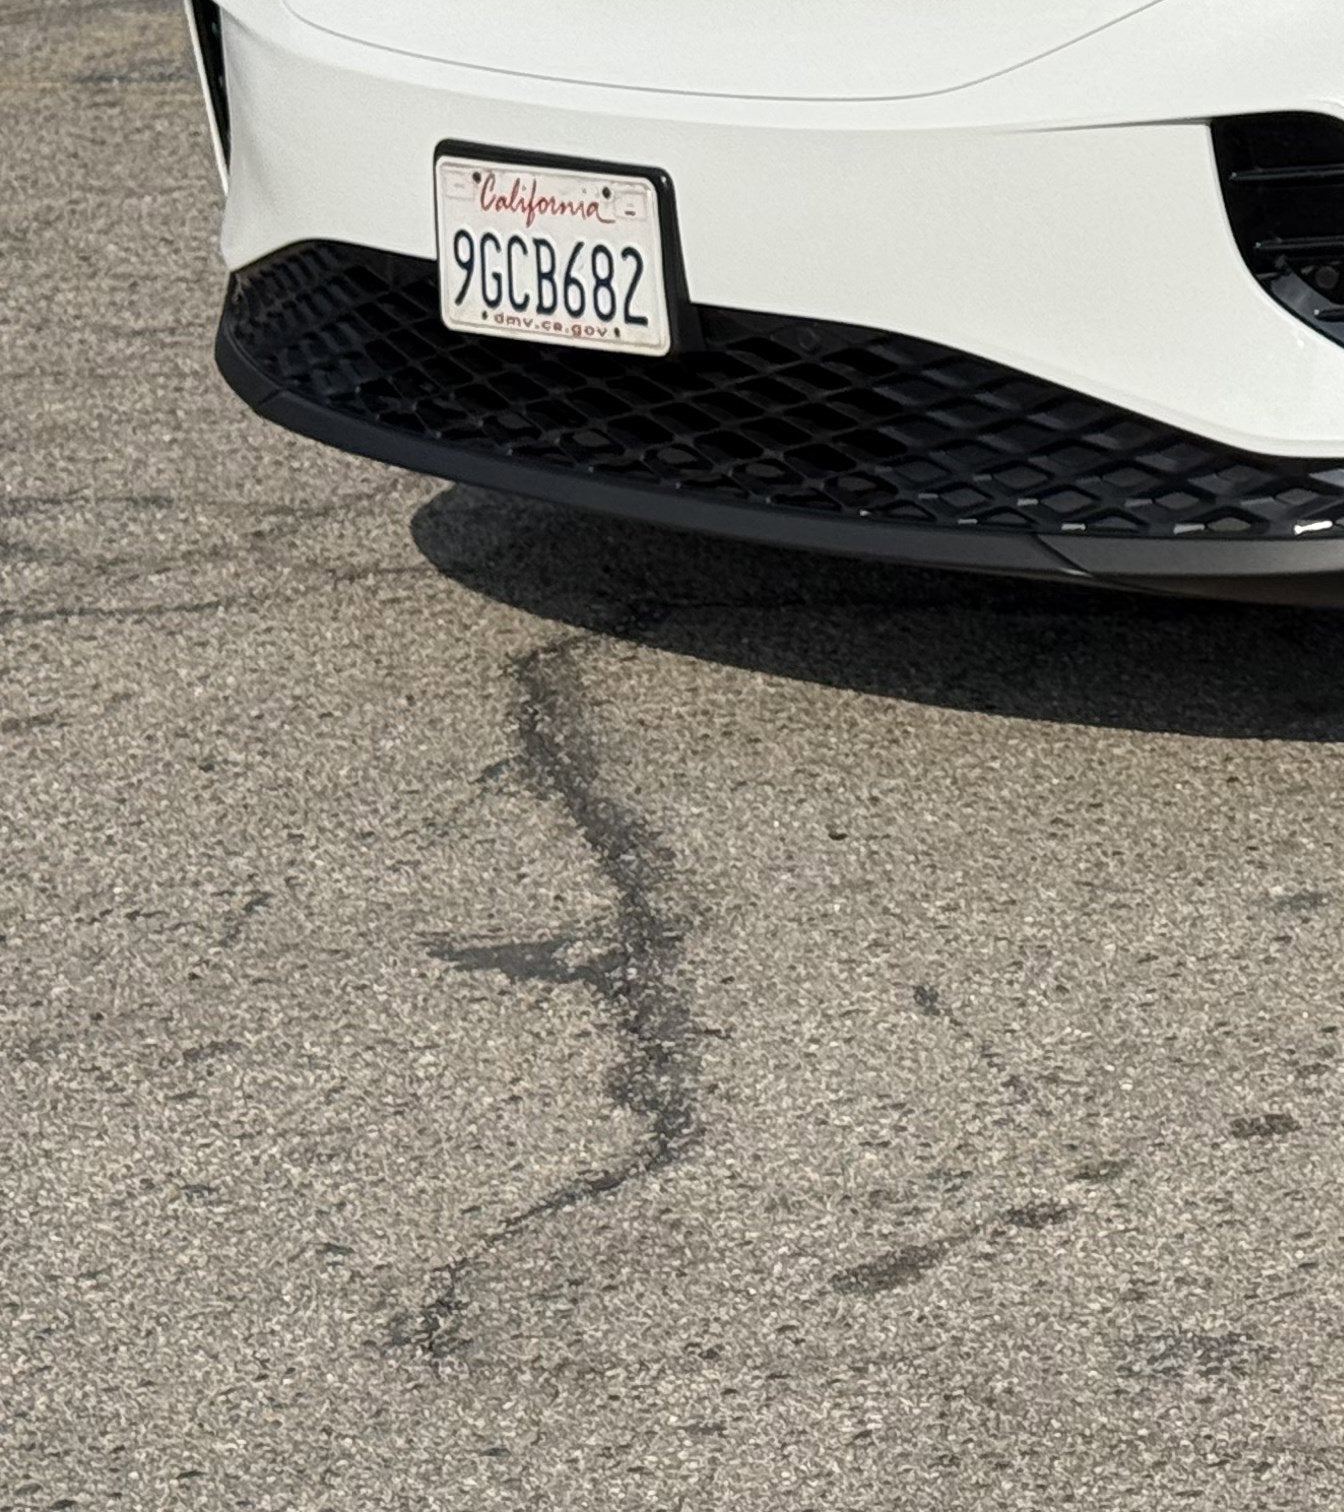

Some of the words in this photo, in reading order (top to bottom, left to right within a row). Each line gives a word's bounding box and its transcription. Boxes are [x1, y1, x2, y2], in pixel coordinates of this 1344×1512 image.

[479, 173, 615, 228] California
[453, 228, 649, 327] 9GCB682
[493, 311, 609, 338] dmv.ca.gov
